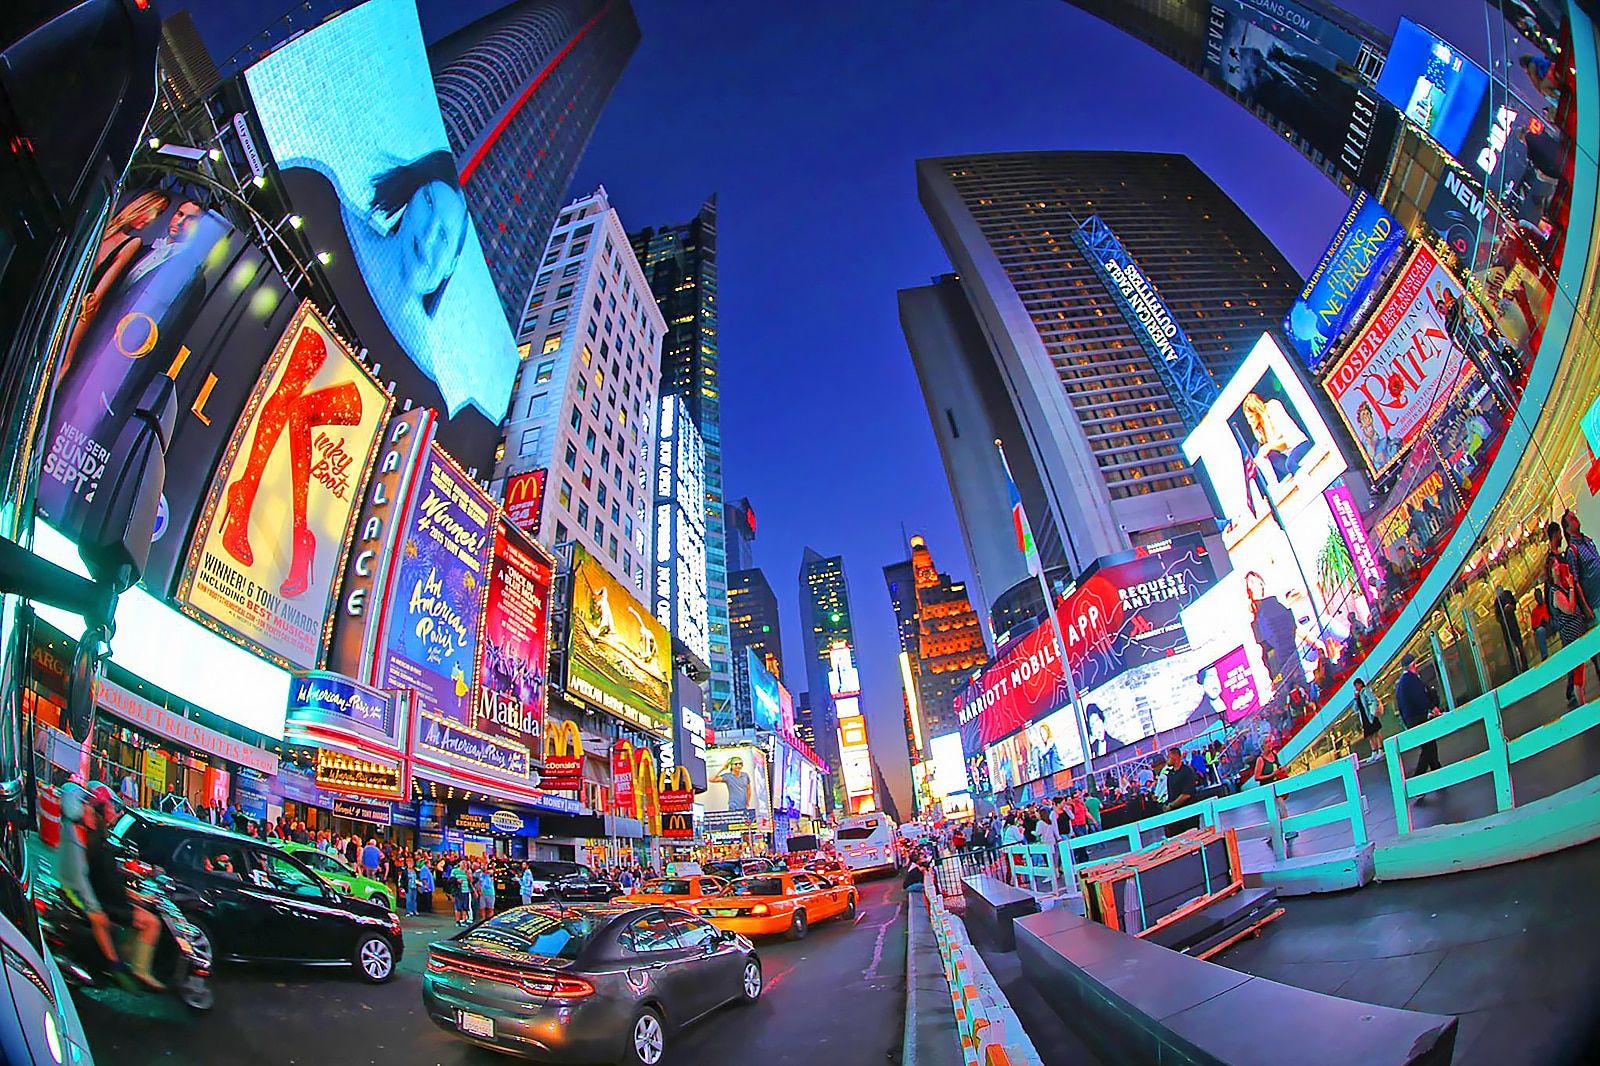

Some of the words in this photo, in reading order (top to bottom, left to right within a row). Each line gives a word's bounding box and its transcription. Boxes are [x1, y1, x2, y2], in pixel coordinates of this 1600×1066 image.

[1206, 5, 1227, 65] NEVER
[1341, 89, 1377, 172] EVEREST
[243, 137, 262, 175] outdoor
[1443, 170, 1491, 222] NEW
[1104, 258, 1132, 296] EAGLE
[1300, 254, 1331, 300] BROADWAY'S
[1325, 226, 1348, 258] BIGGEST
[1343, 207, 1358, 228] NEW
[1315, 213, 1393, 327] NEVERLAND
[1324, 227, 1368, 289] FINDING
[1123, 264, 1177, 338] OUTFITTERS
[1379, 298, 1399, 323] BEST
[1394, 253, 1430, 300] MUSICAL!
[1384, 311, 1400, 331] 2015
[1396, 291, 1416, 315] TONY
[1411, 260, 1434, 294] AWARD
[1128, 292, 1179, 361] AMERICAN
[1359, 296, 1425, 380] SOMETHING
[1329, 321, 1387, 395] LOSER!
[60, 421, 86, 446] NEW
[85, 438, 111, 463] SERI
[43, 453, 87, 494] SEPT
[347, 422, 410, 616] PALACE
[420, 489, 486, 556] Winner!
[508, 500, 534, 511] OPEN
[510, 507, 530, 520] 24
[430, 525, 445, 544] 2015
[444, 534, 460, 555] TONY
[458, 547, 481, 573] AWARDS
[199, 570, 245, 605] INCLUDING
[246, 600, 273, 621] BEST
[203, 552, 247, 594] WINNER!
[246, 581, 254, 598] 6
[255, 585, 281, 613] TONY
[281, 603, 319, 637] AWARDS
[424, 567, 443, 599] An
[498, 569, 504, 580] A
[504, 573, 522, 593] BLUE
[524, 580, 534, 592] IN
[656, 565, 671, 602] NOW
[1117, 572, 1185, 599] REQUEST
[1122, 582, 1188, 613] ANYTIME
[409, 579, 468, 647] American
[415, 617, 454, 658] Paris
[958, 680, 1009, 726] MARRIOTT
[1011, 638, 1062, 689] MOBILE
[1068, 605, 1100, 648] APP
[306, 680, 347, 711] American
[348, 694, 371, 719] Paris
[479, 685, 541, 738] Matilda
[191, 729, 241, 761] SUITES
[425, 722, 440, 743] An
[440, 730, 482, 760] American
[485, 746, 506, 768] Paris
[455, 820, 490, 830] EXCHANGE
[461, 813, 483, 823] MONEY
[542, 796, 564, 808] MONEY
